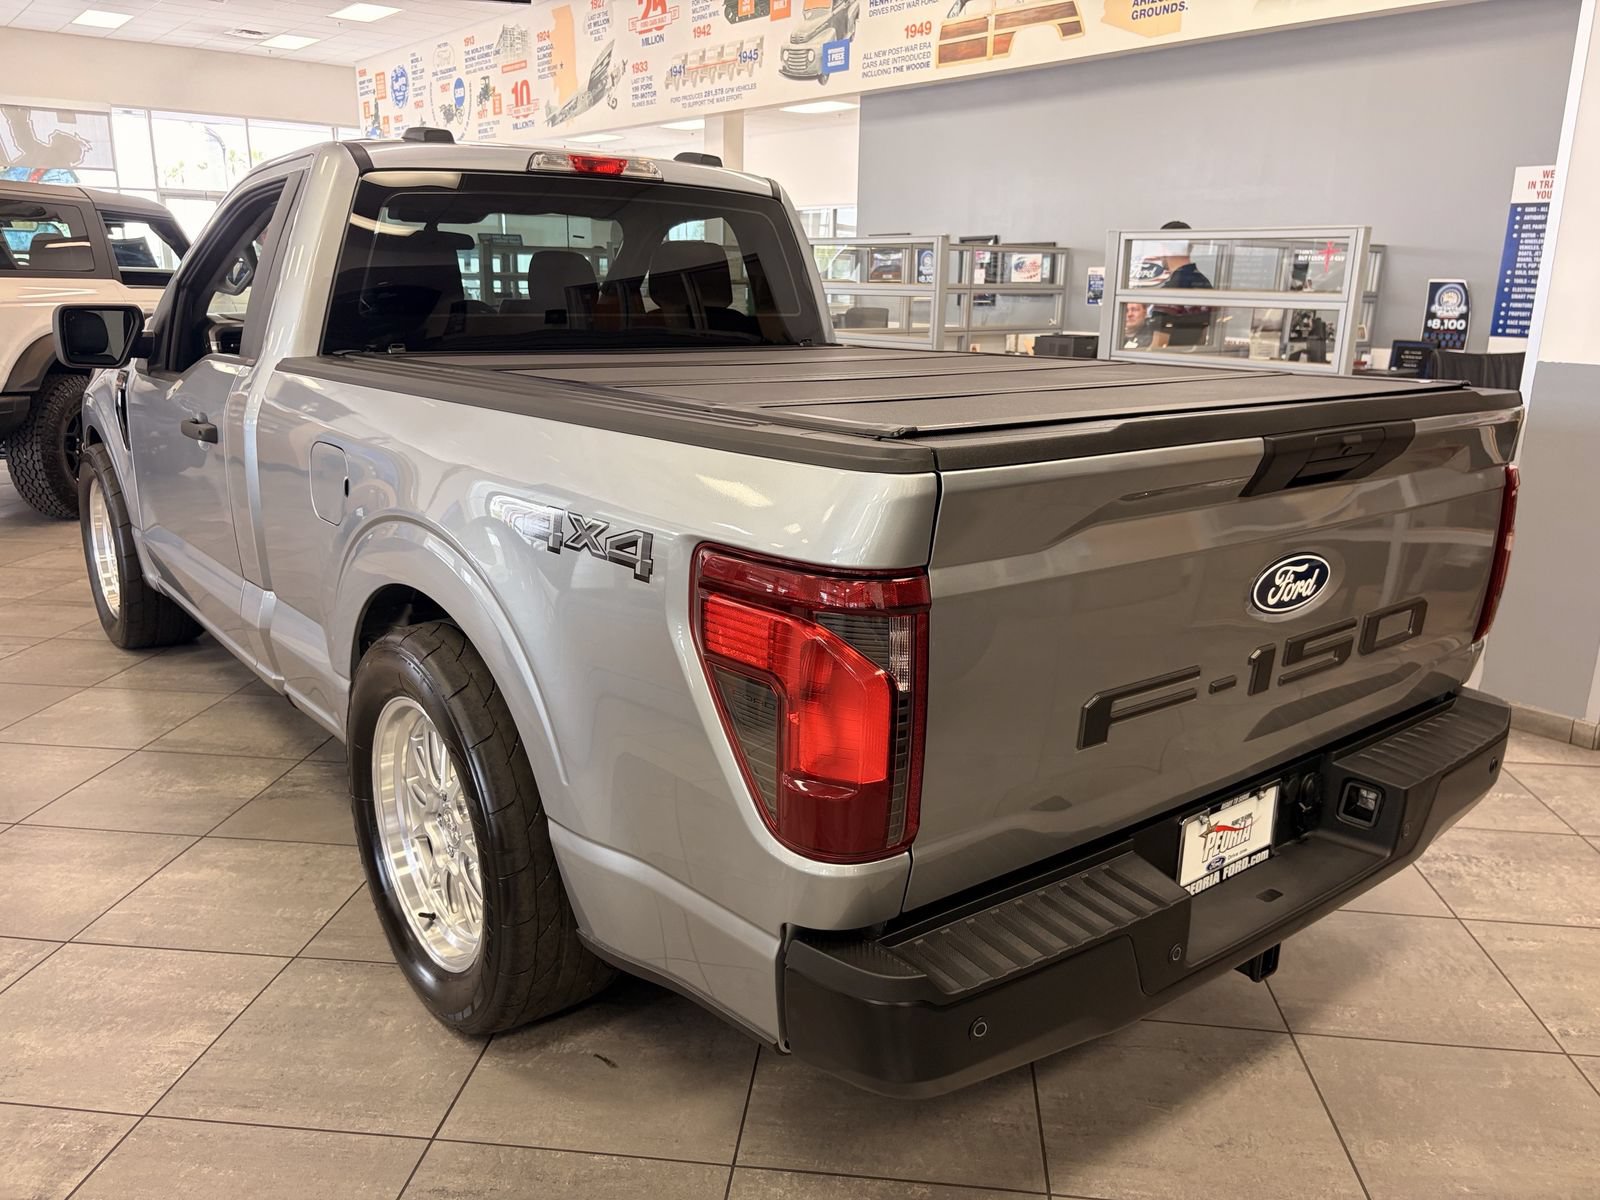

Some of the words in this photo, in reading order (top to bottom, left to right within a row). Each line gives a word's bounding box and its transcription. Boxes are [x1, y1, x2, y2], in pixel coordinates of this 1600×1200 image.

[869, 6, 889, 17] DRIVES
[890, 2, 905, 12] POST
[1131, 1, 1188, 20] GROUNDS.
[692, 24, 712, 39] 1942
[904, 20, 932, 39] 1949
[642, 34, 664, 47] MILLION
[919, 42, 931, 50] ERA
[738, 48, 758, 64] 1945
[862, 60, 877, 69] CARS
[892, 51, 931, 64] INTRODUCED
[632, 60, 648, 74] 1933
[670, 64, 686, 77] 1941
[862, 67, 892, 78] INCLUDING
[906, 61, 931, 71] WOODIE
[511, 79, 531, 114] 10
[1528, 181, 1536, 189] IN
[1130, 263, 1156, 279] Ford
[1427, 319, 1466, 331] $8,100
[1267, 562, 1320, 606] Ford
[1077, 597, 1428, 752] F-150
[1201, 817, 1253, 864] PEORIA
[1222, 849, 1270, 880] FORD.com
